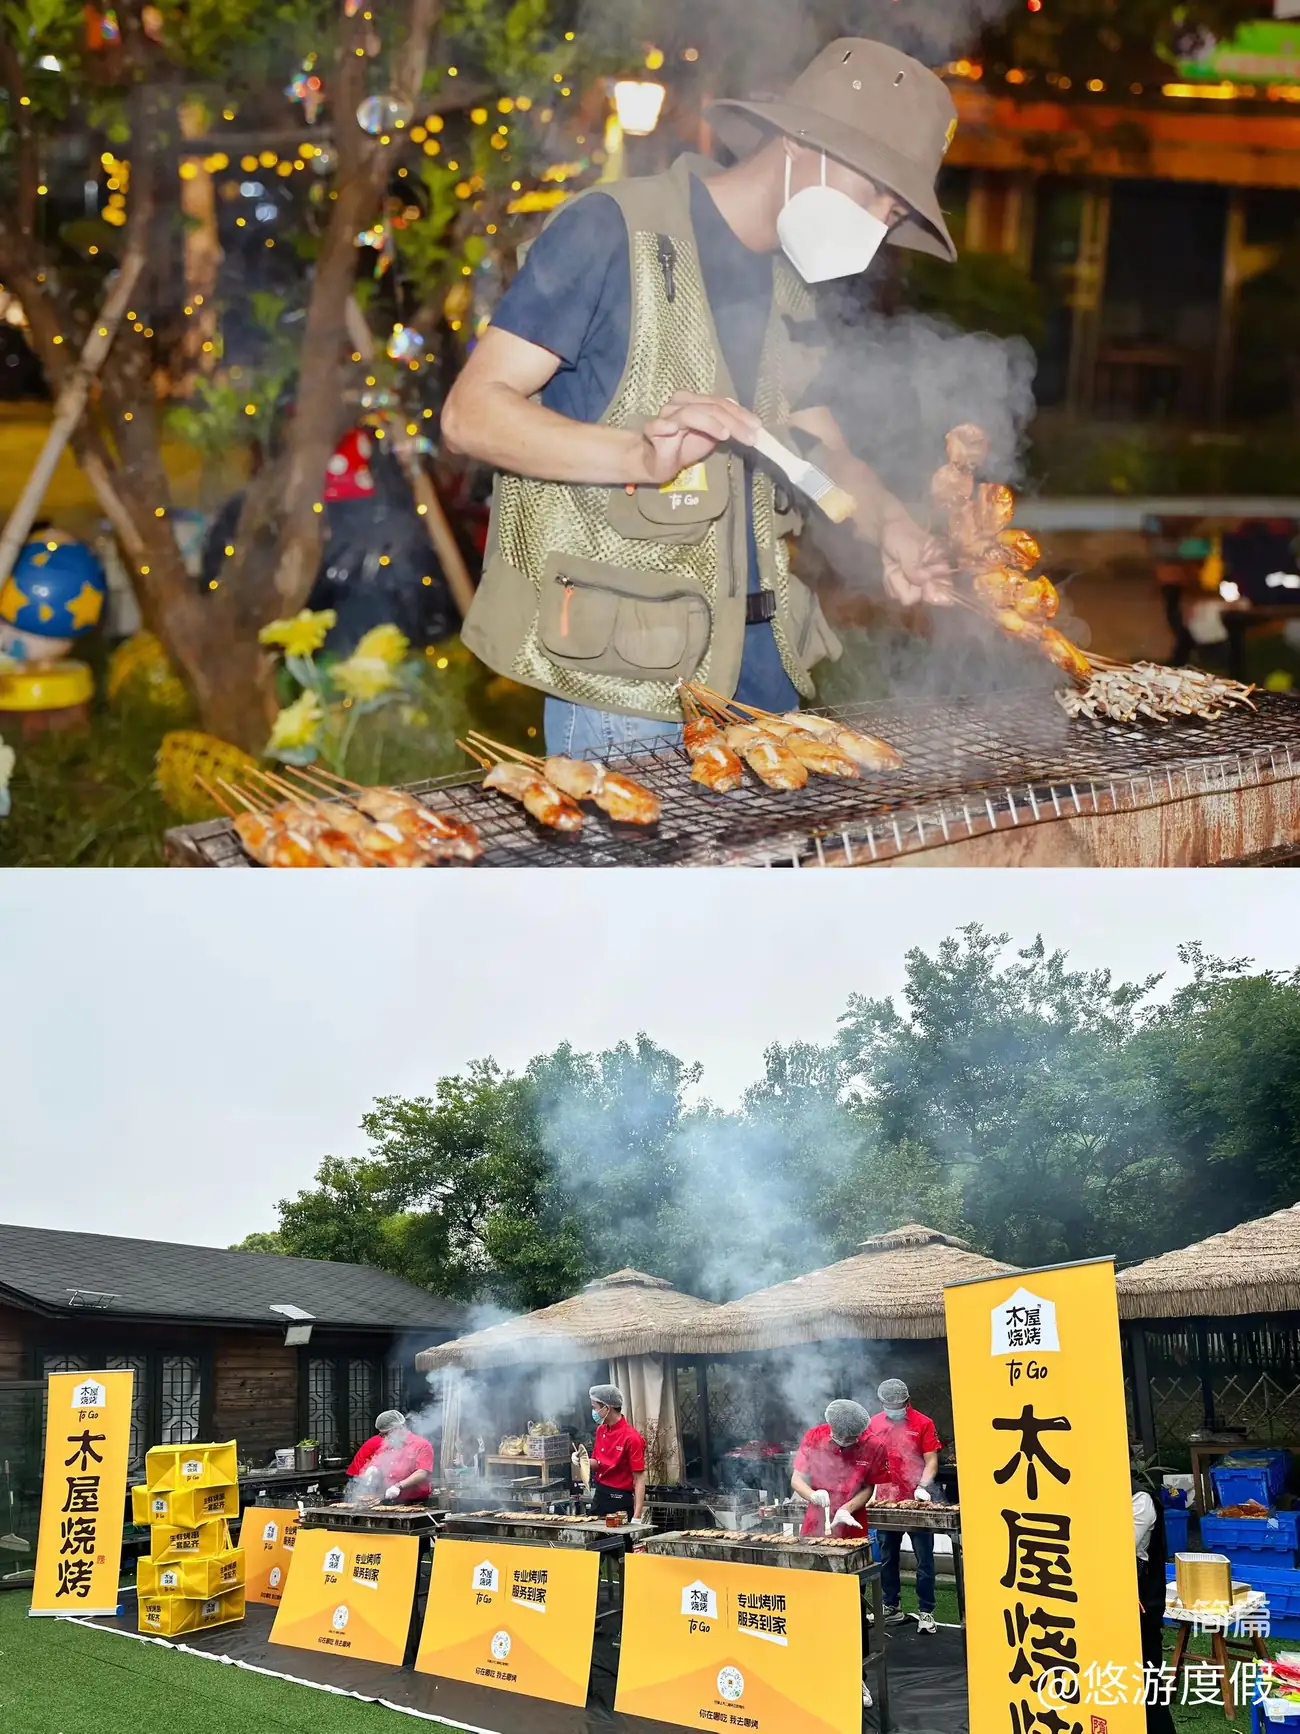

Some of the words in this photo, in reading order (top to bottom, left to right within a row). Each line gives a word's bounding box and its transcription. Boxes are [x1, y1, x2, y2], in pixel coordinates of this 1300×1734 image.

[684, 494, 699, 505] Go
[1006, 1306, 1041, 1327] 木屋
[1008, 1327, 1041, 1347] 烧烤
[1006, 1359, 1023, 1386] To
[1026, 1361, 1048, 1379] Go
[55, 1430, 106, 1597] 木屋烧烤
[356, 1553, 381, 1565] 专业烤师
[353, 1567, 379, 1581] 服务到家
[514, 1570, 548, 1584] 专业烤师
[512, 1585, 546, 1603] 服务到家
[737, 1593, 786, 1612] 专业烤师
[737, 1611, 787, 1635] 服务到家
